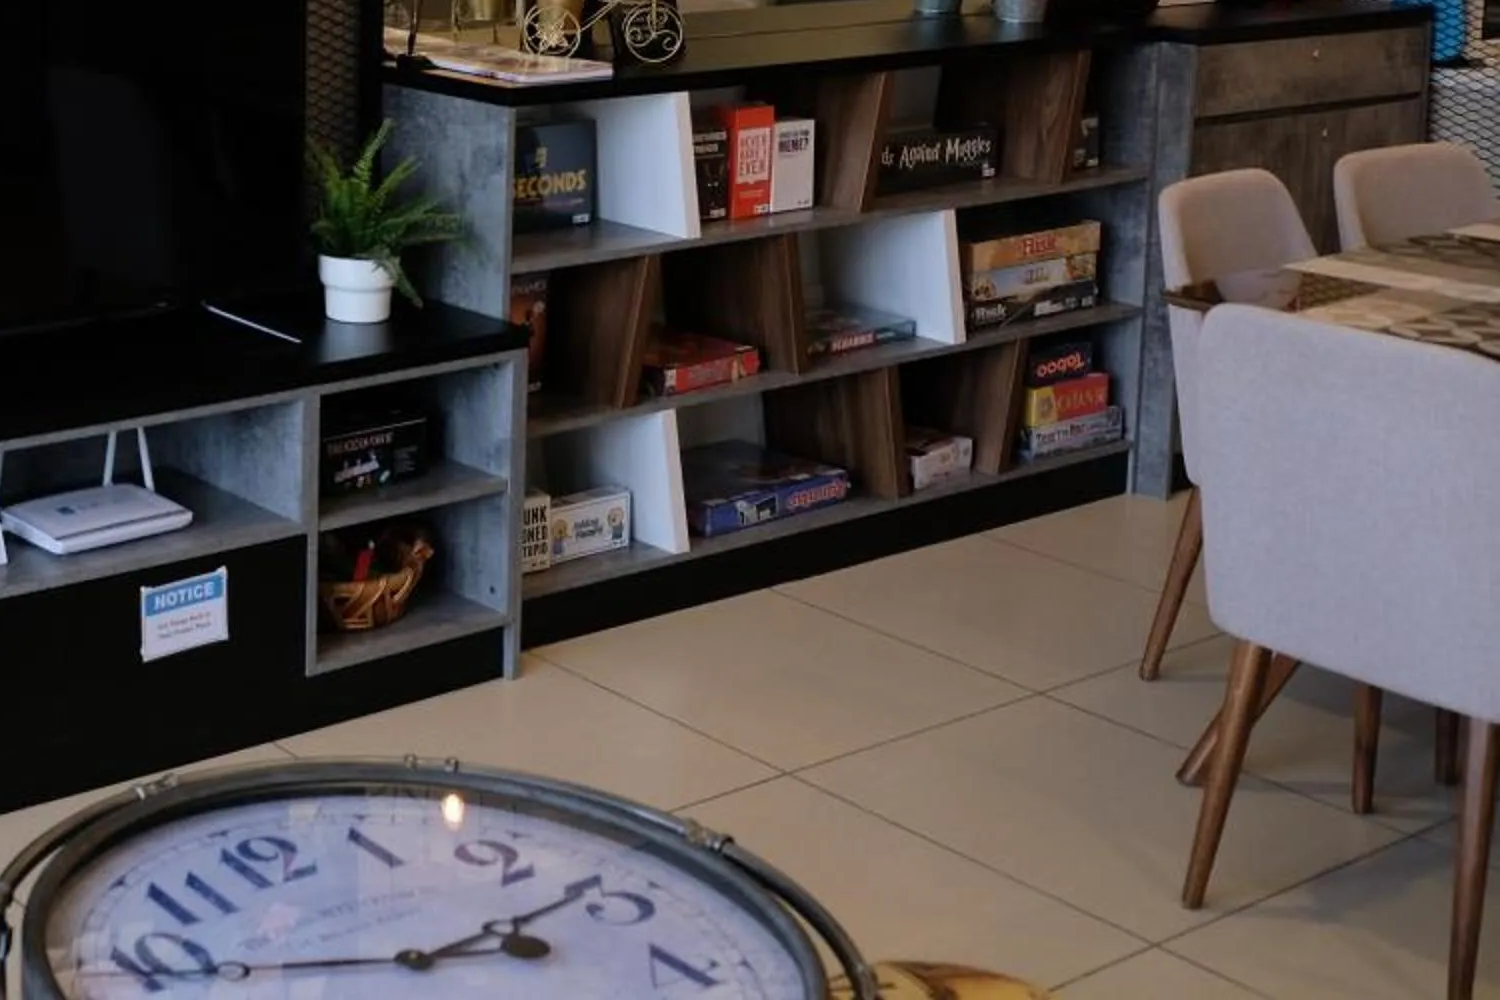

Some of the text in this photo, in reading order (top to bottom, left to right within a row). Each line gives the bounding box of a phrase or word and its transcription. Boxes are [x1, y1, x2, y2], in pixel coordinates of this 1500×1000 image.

[514, 170, 587, 198] ECONDS
[153, 580, 216, 611] NOTICE
[220, 834, 318, 890] 12
[346, 827, 406, 868] 1
[453, 839, 536, 888] 2
[146, 881, 241, 926] 11
[563, 874, 657, 926] 3
[109, 931, 217, 993] 10
[647, 942, 722, 990] 4
